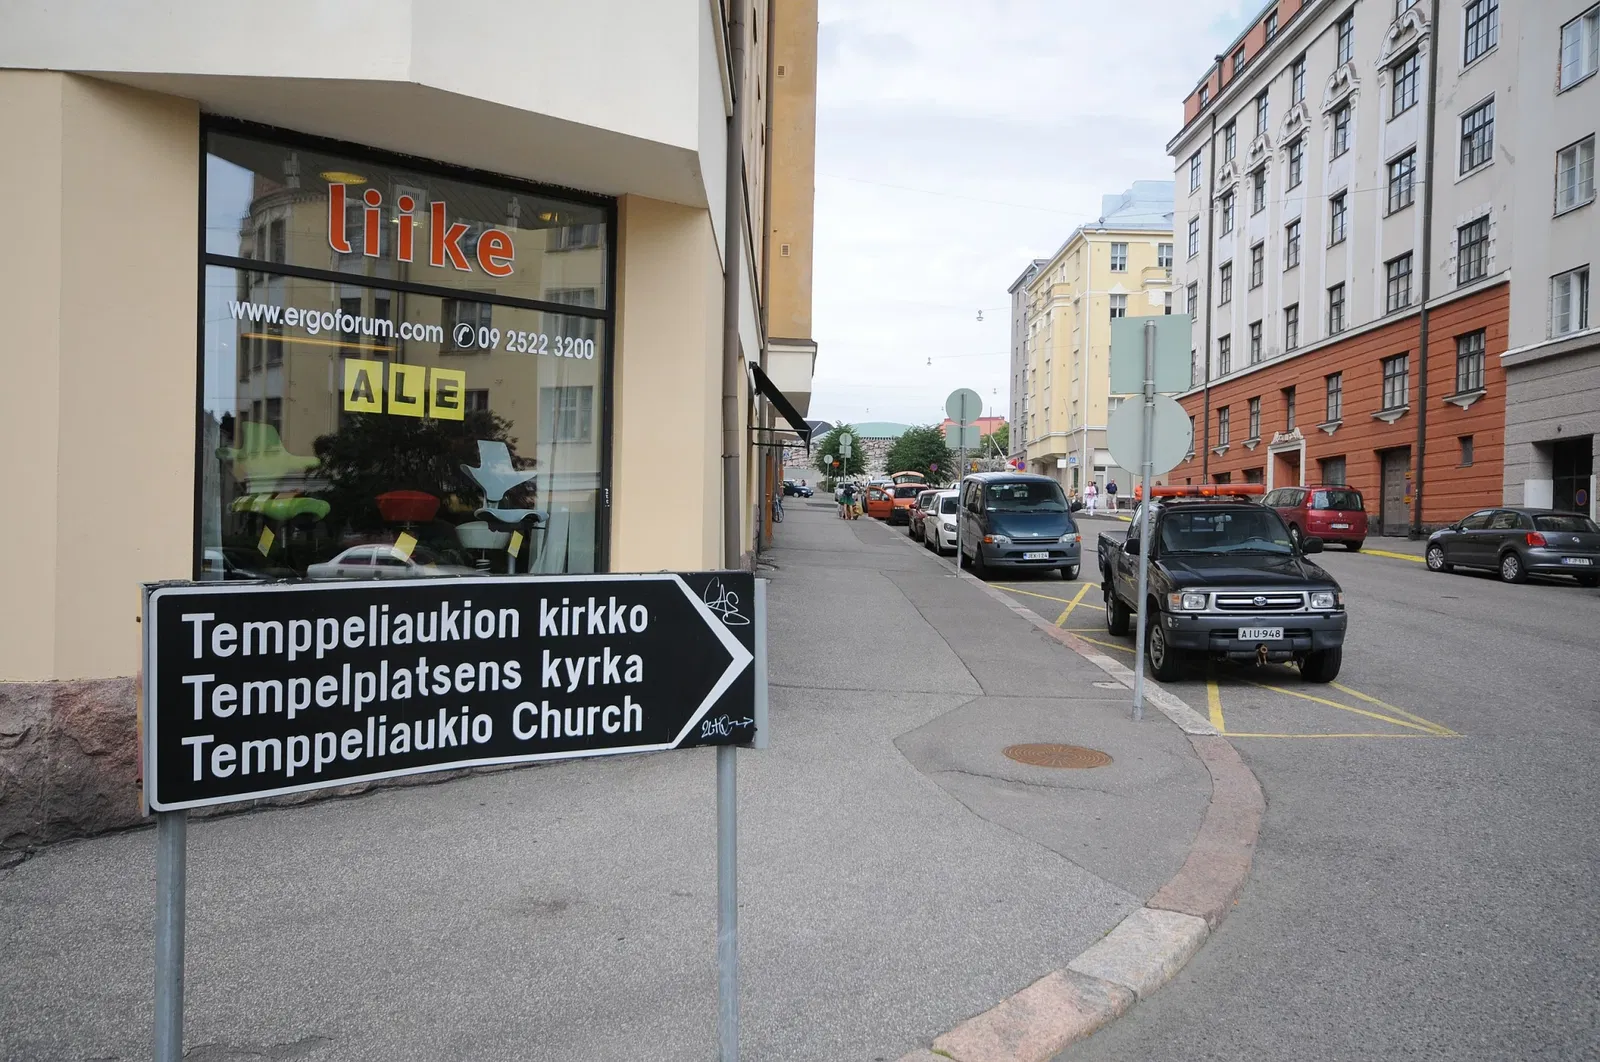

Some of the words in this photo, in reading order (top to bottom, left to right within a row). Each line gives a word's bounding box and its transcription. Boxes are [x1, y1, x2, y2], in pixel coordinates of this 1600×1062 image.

[328, 183, 515, 277] liike
[228, 300, 443, 343] www.ergoforum.com
[478, 326, 500, 349] 09
[506, 330, 548, 355] 2522
[554, 335, 594, 360] 3200
[350, 368, 459, 409] ALE
[181, 600, 520, 661] Temppeliaukion
[539, 597, 648, 637] kirkko
[1241, 629, 1281, 638] AIU-948
[181, 656, 522, 720] Tempelplatsens
[542, 647, 643, 691] kyrka
[181, 706, 493, 782] Temppeliaukio
[513, 696, 643, 740] Church
